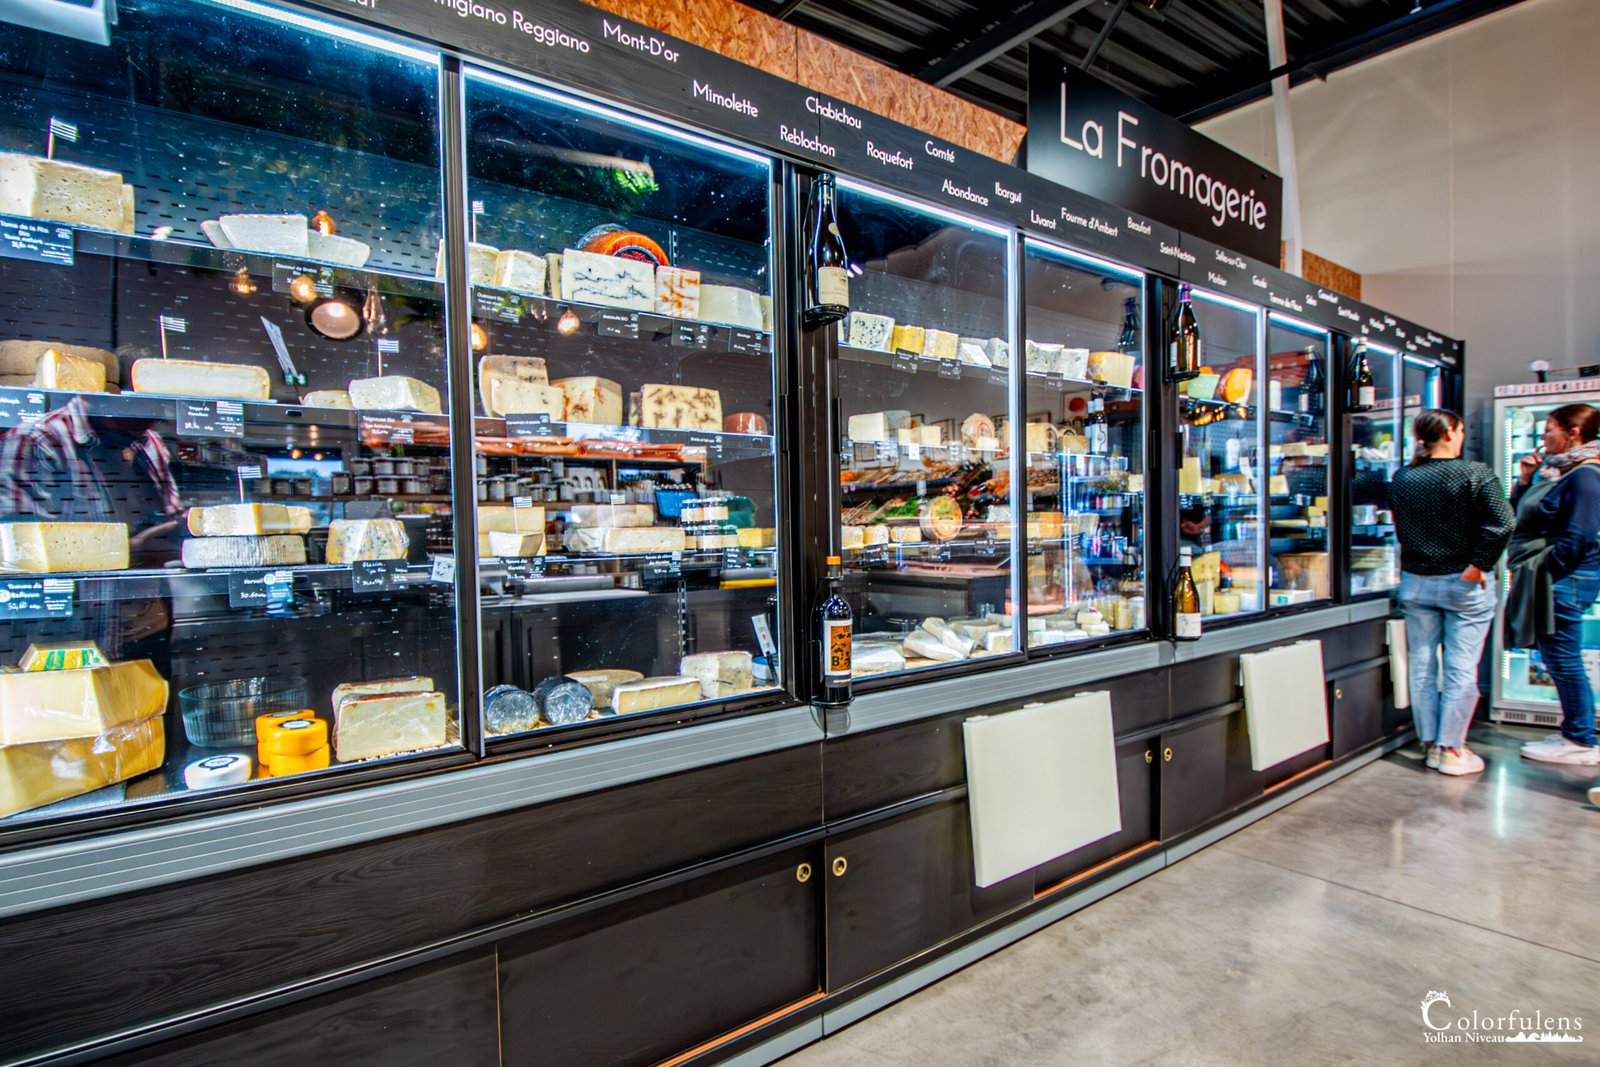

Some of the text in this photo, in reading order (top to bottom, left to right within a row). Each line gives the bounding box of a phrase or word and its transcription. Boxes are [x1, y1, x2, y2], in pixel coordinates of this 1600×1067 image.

[512, 10, 590, 53] Reggiano
[603, 18, 680, 63] Mont-D'or
[693, 79, 759, 118] Mimolette
[805, 96, 862, 129] Chabichou
[780, 124, 836, 157] Reblochon
[866, 140, 914, 170] Roquefort
[924, 140, 955, 163] Comté
[1060, 81, 1267, 231] La Fromagerie
[941, 179, 989, 207] Abondance
[1030, 209, 1057, 230] Livarot
[1061, 207, 1119, 237] Fourme d'Ambert
[1127, 216, 1152, 236] Beaufort
